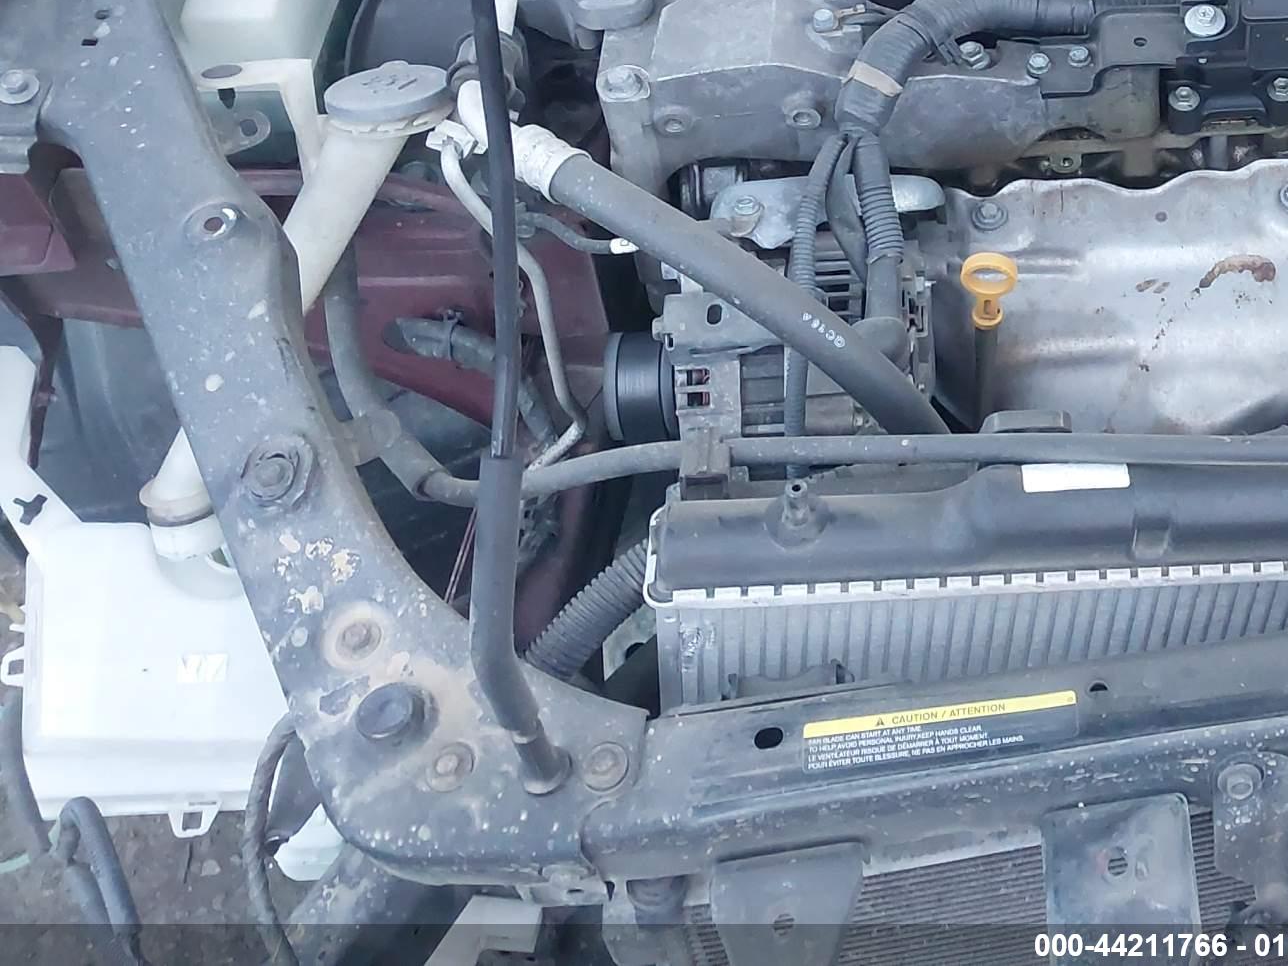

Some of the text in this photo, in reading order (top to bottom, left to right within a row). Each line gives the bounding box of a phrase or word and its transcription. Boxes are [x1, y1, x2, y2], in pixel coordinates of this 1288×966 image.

[891, 712, 938, 725] CAUTION
[949, 703, 1006, 717] ATTENTION
[819, 744, 836, 752] HELP
[837, 741, 858, 750] AVOID
[858, 737, 893, 747] PERSONAL
[935, 728, 959, 737] HANDS
[845, 734, 860, 742] CAN
[861, 730, 882, 740] START
[891, 727, 905, 735] ANY
[808, 762, 828, 770] POUR
[828, 757, 851, 768] ÉVITER
[852, 754, 873, 764] TOUTE
[922, 746, 935, 755] PAS
[946, 740, 988, 752] APPROCHER
[989, 738, 1001, 746] LES
[817, 749, 860, 762] VENTILATEUR
[941, 736, 957, 745] TOUT
